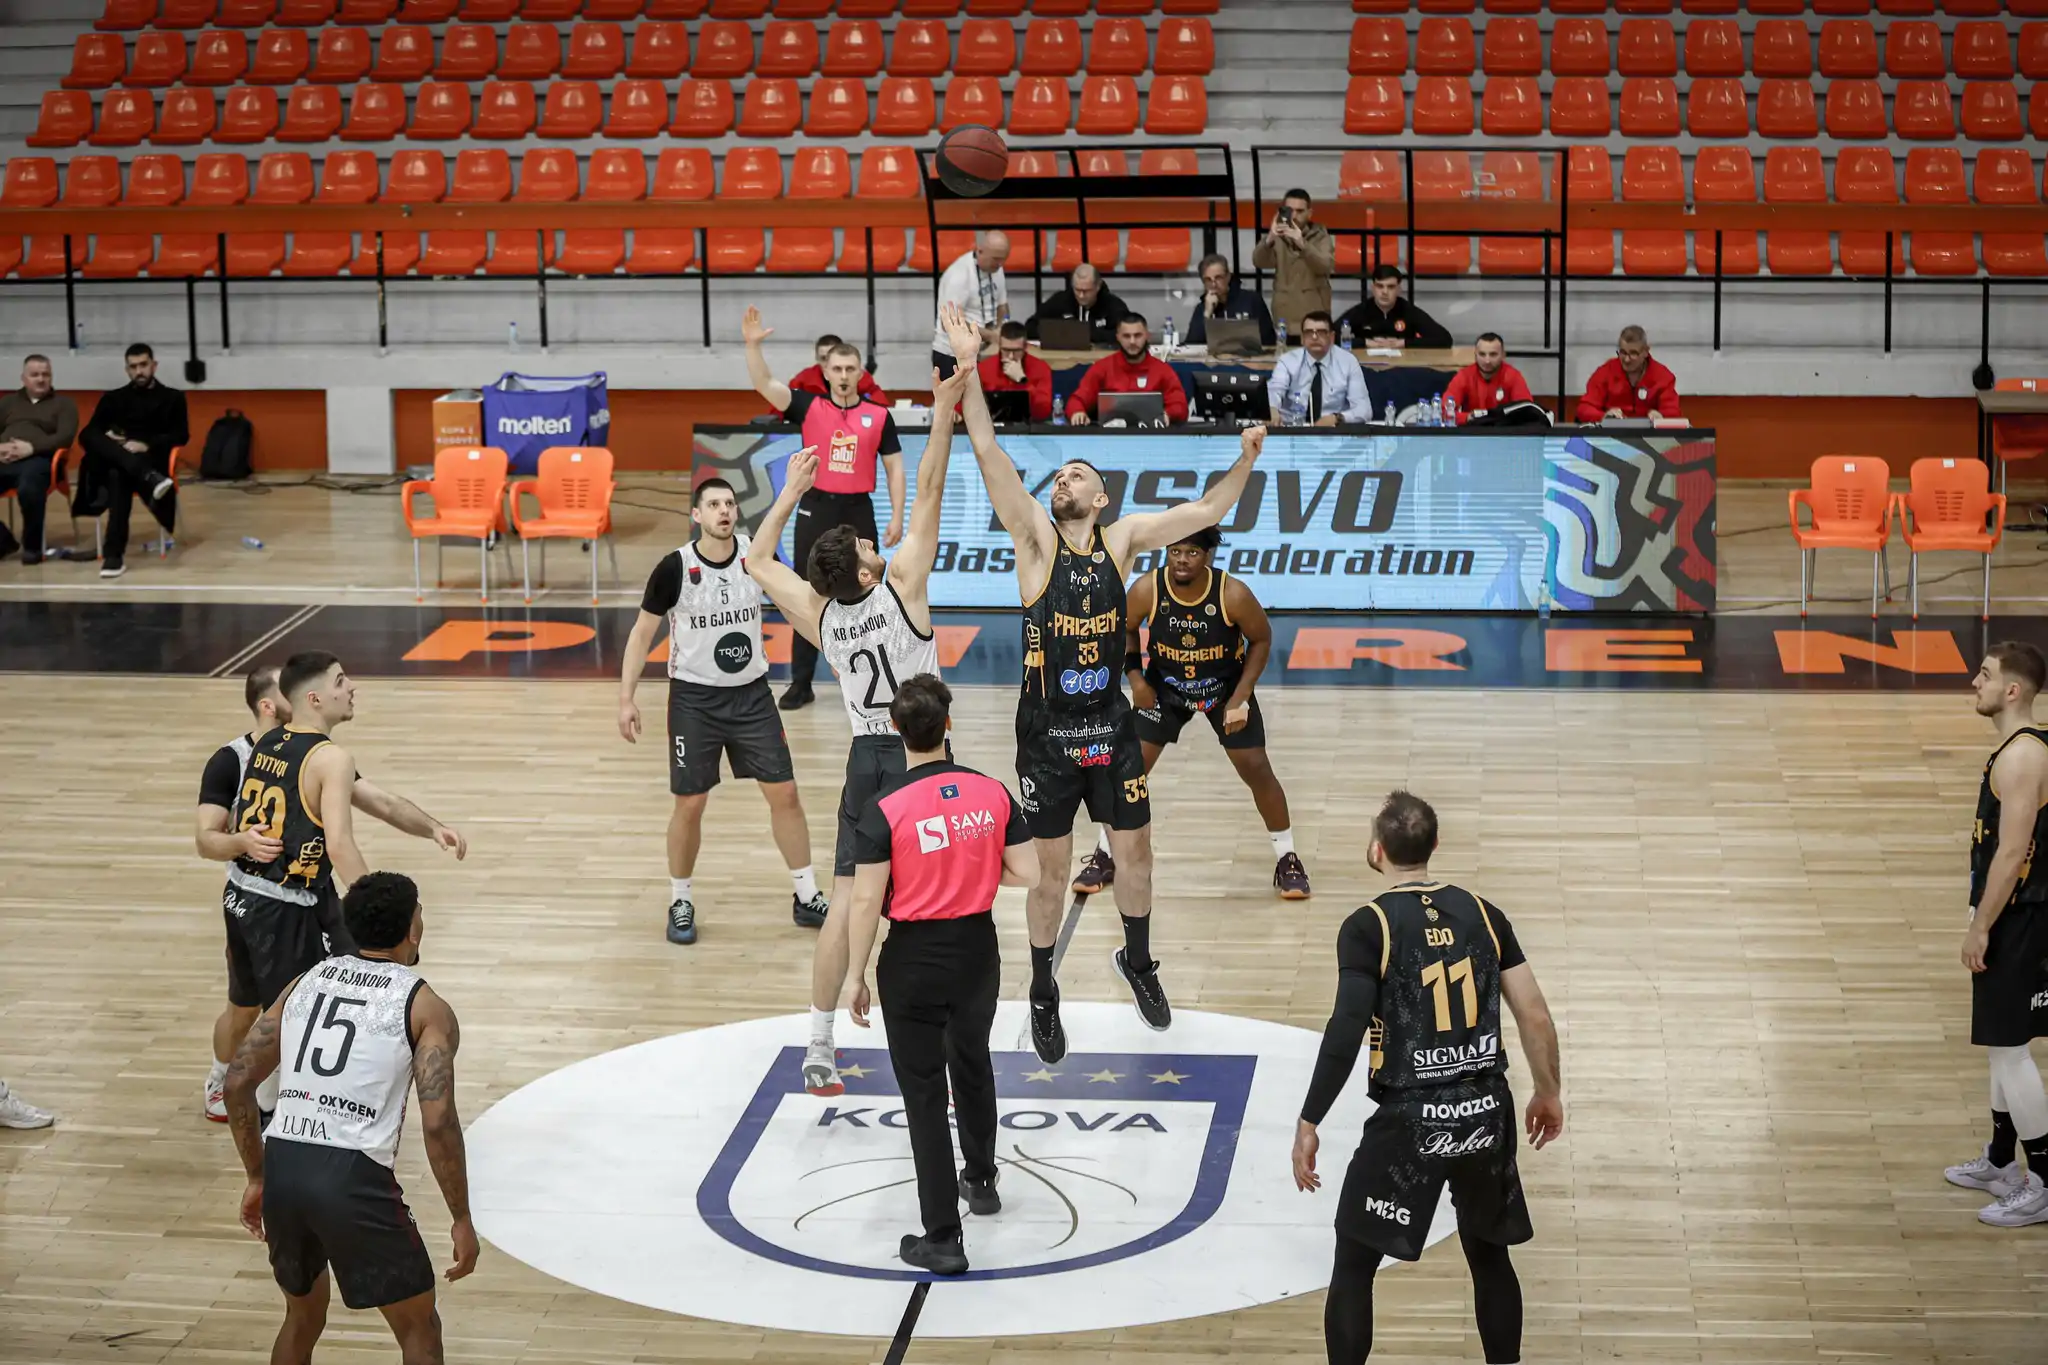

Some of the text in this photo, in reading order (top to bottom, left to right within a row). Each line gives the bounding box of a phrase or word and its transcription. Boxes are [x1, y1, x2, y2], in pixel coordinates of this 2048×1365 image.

[498, 414, 572, 435] molten
[720, 589, 729, 605] 5
[690, 615, 707, 630] KB
[1168, 615, 1208, 630] Proton
[832, 627, 848, 642] KB
[717, 644, 751, 658] TROJA
[1077, 640, 1100, 666] 33
[1184, 664, 1196, 679] 3
[675, 735, 686, 758] 5
[253, 752, 290, 779] BYTYQI
[1123, 774, 1149, 804] 33
[238, 777, 287, 841] 20
[950, 809, 996, 831] SAVA
[1424, 927, 1455, 947] EDO
[318, 965, 393, 990] KB GJAKOVA
[1420, 955, 1479, 1032] 11
[293, 991, 368, 1078] 15
[1413, 1043, 1478, 1067] SIGMA
[1415, 1068, 1442, 1080] VIENNA
[318, 1094, 378, 1120] OXYGEN
[816, 1106, 1169, 1133] KOOVA
